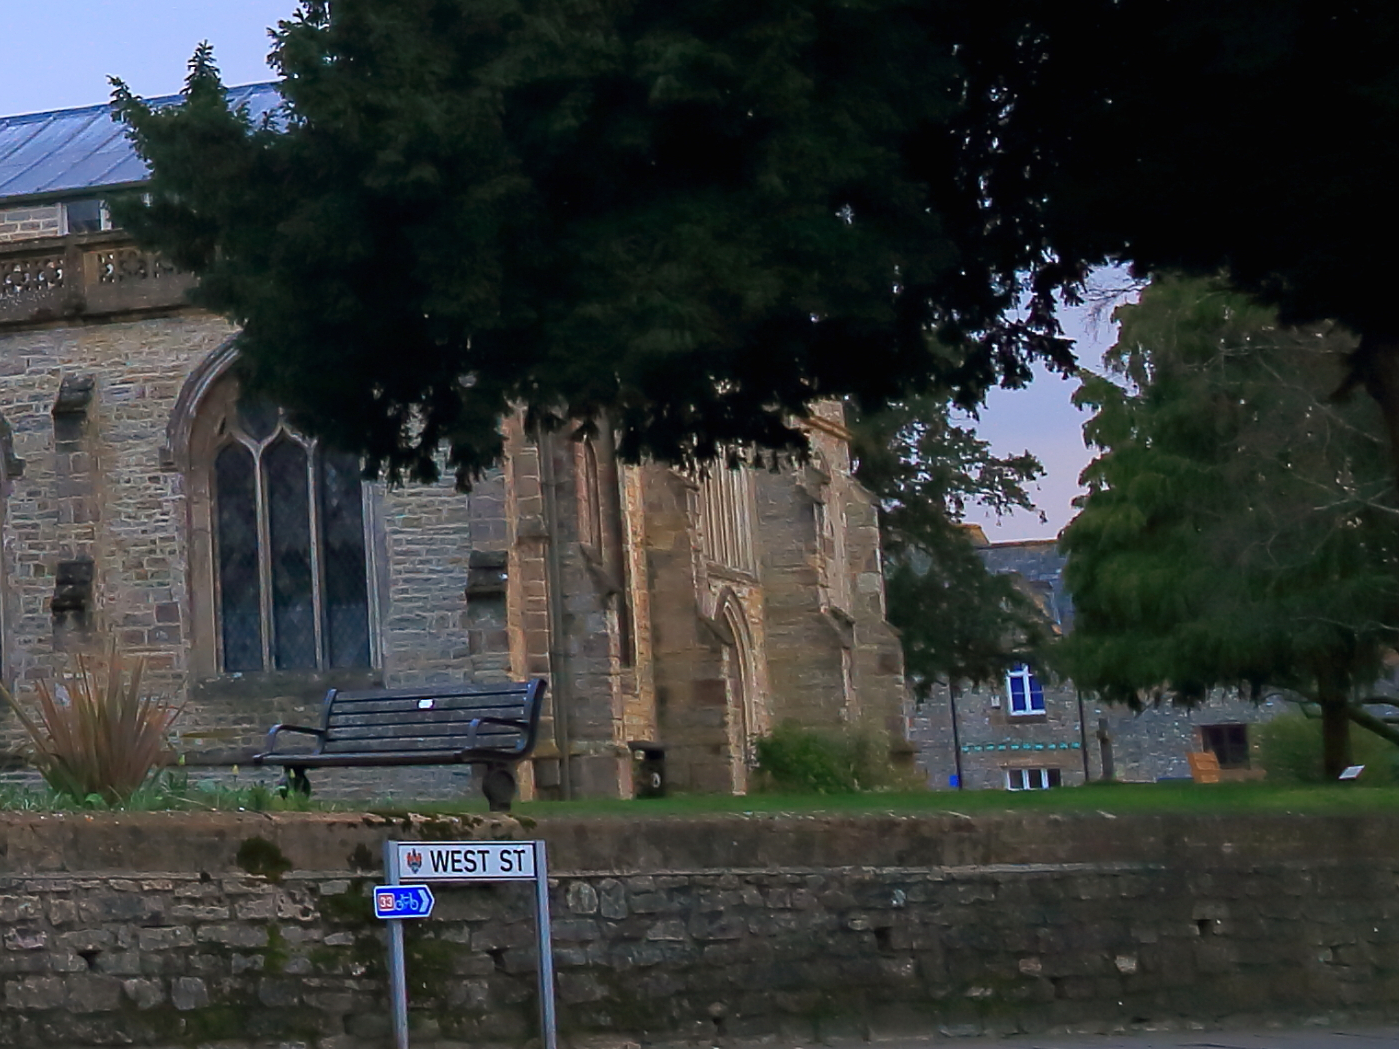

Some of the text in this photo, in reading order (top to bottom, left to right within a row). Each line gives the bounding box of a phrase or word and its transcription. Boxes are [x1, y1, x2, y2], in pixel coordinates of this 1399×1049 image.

[430, 849, 526, 873] WEST ST
[380, 896, 393, 908] 33
